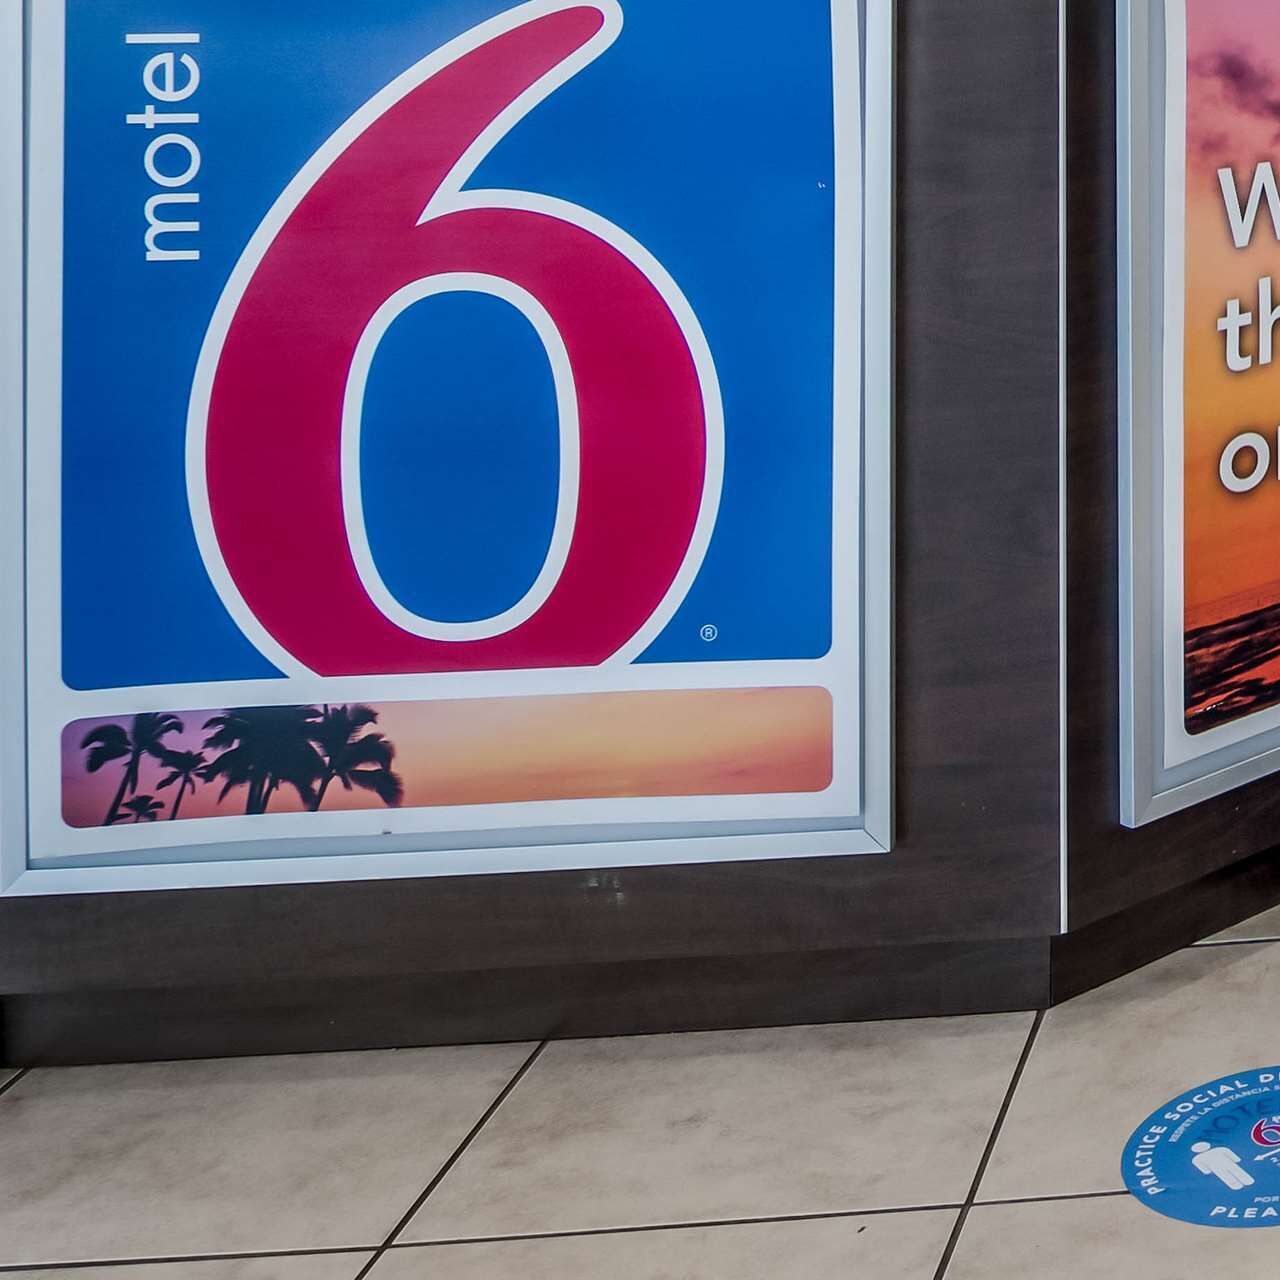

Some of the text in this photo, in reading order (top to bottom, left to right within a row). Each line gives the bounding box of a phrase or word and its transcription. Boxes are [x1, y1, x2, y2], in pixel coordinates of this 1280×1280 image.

[126, 32, 200, 262] motel
[1134, 1125, 1168, 1195] PRACTICE
[1164, 1080, 1248, 1121] SOCIAL
[1168, 1115, 1200, 1142] RESPETE
[1197, 1106, 1212, 1116] LA
[1212, 1086, 1270, 1108] DISTANCIA
